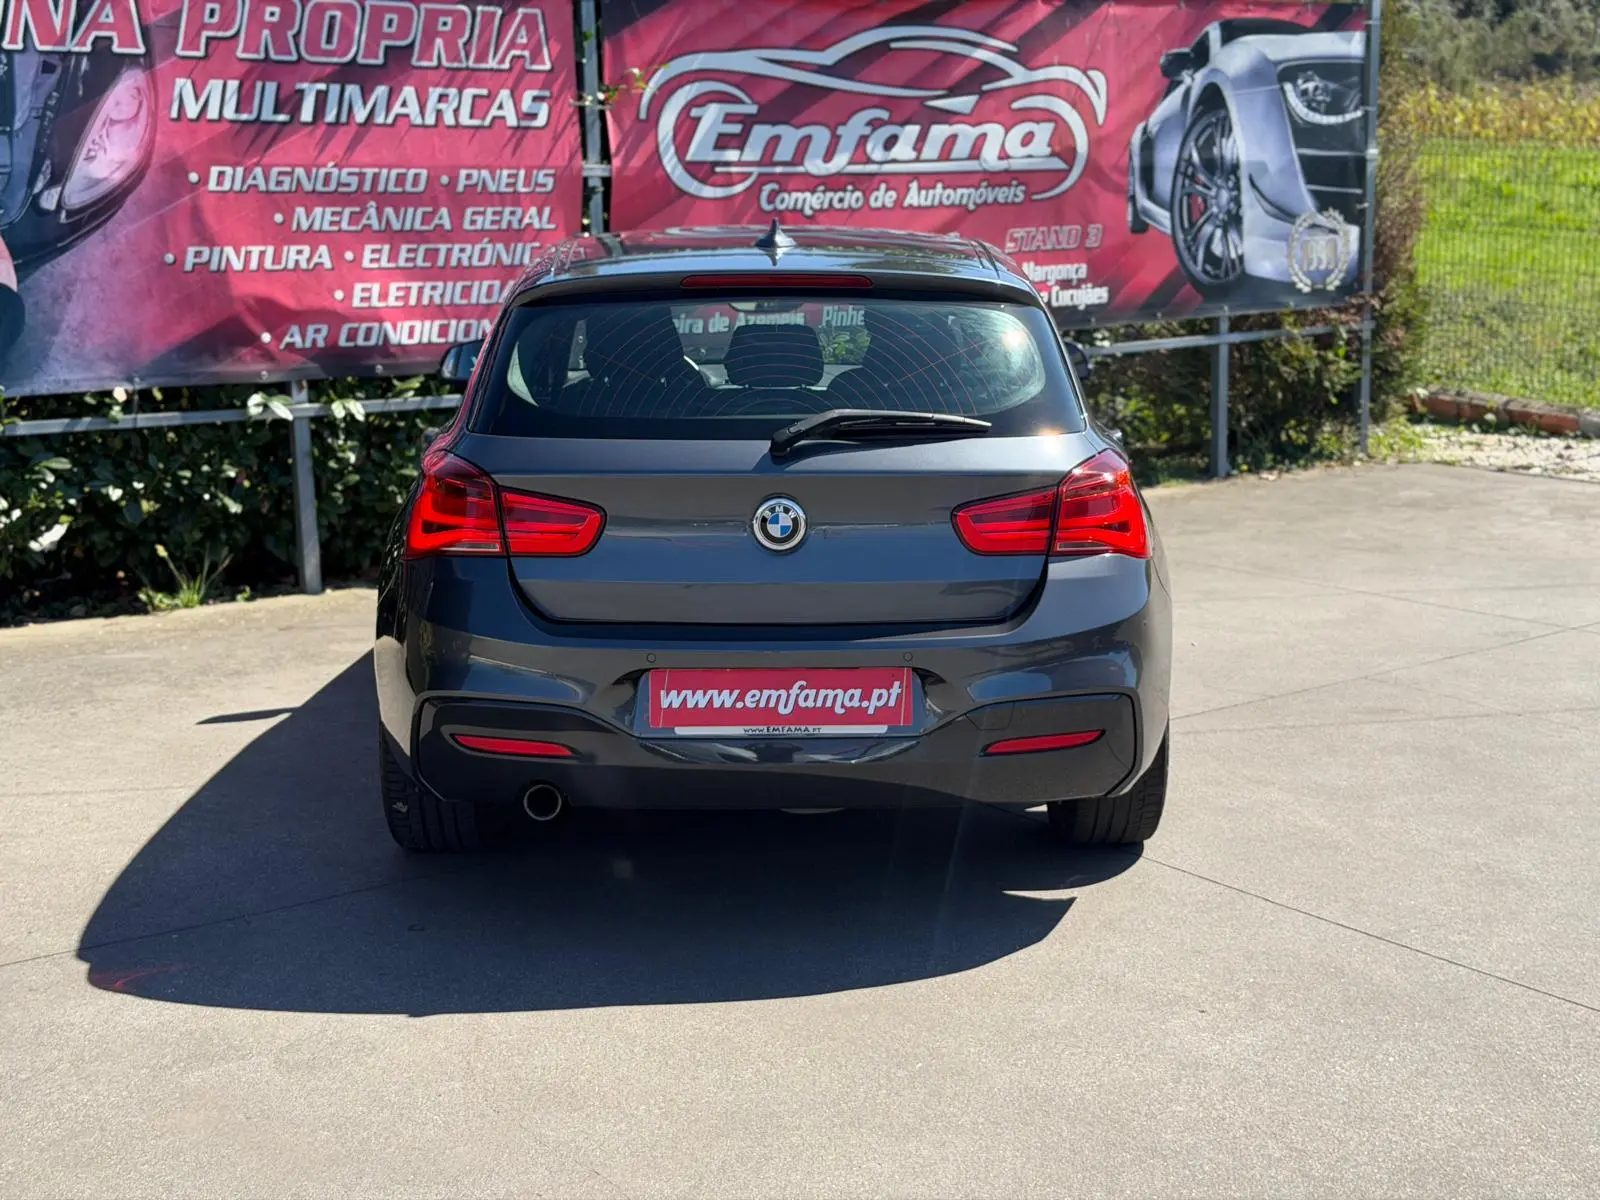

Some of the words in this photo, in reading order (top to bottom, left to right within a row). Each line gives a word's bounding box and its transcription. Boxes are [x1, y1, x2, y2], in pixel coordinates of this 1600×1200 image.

[170, 78, 550, 127] MULTIMARCAS
[685, 102, 1055, 176] Emfama
[207, 162, 429, 193] DIAGNÓSTICO
[456, 168, 556, 193] PNEUS
[760, 182, 864, 216] Comércio
[869, 183, 896, 209] de
[903, 179, 1026, 211] Automóveis
[291, 201, 452, 232] MECÂNICA
[462, 206, 556, 230] GERAL
[1004, 226, 1082, 253] STAND
[1084, 224, 1103, 248] 3
[183, 245, 332, 272] PINTURA
[279, 324, 328, 349] AR
[708, 312, 730, 333] de
[763, 505, 797, 518] BMW
[660, 680, 901, 715] www.emfama.pt
